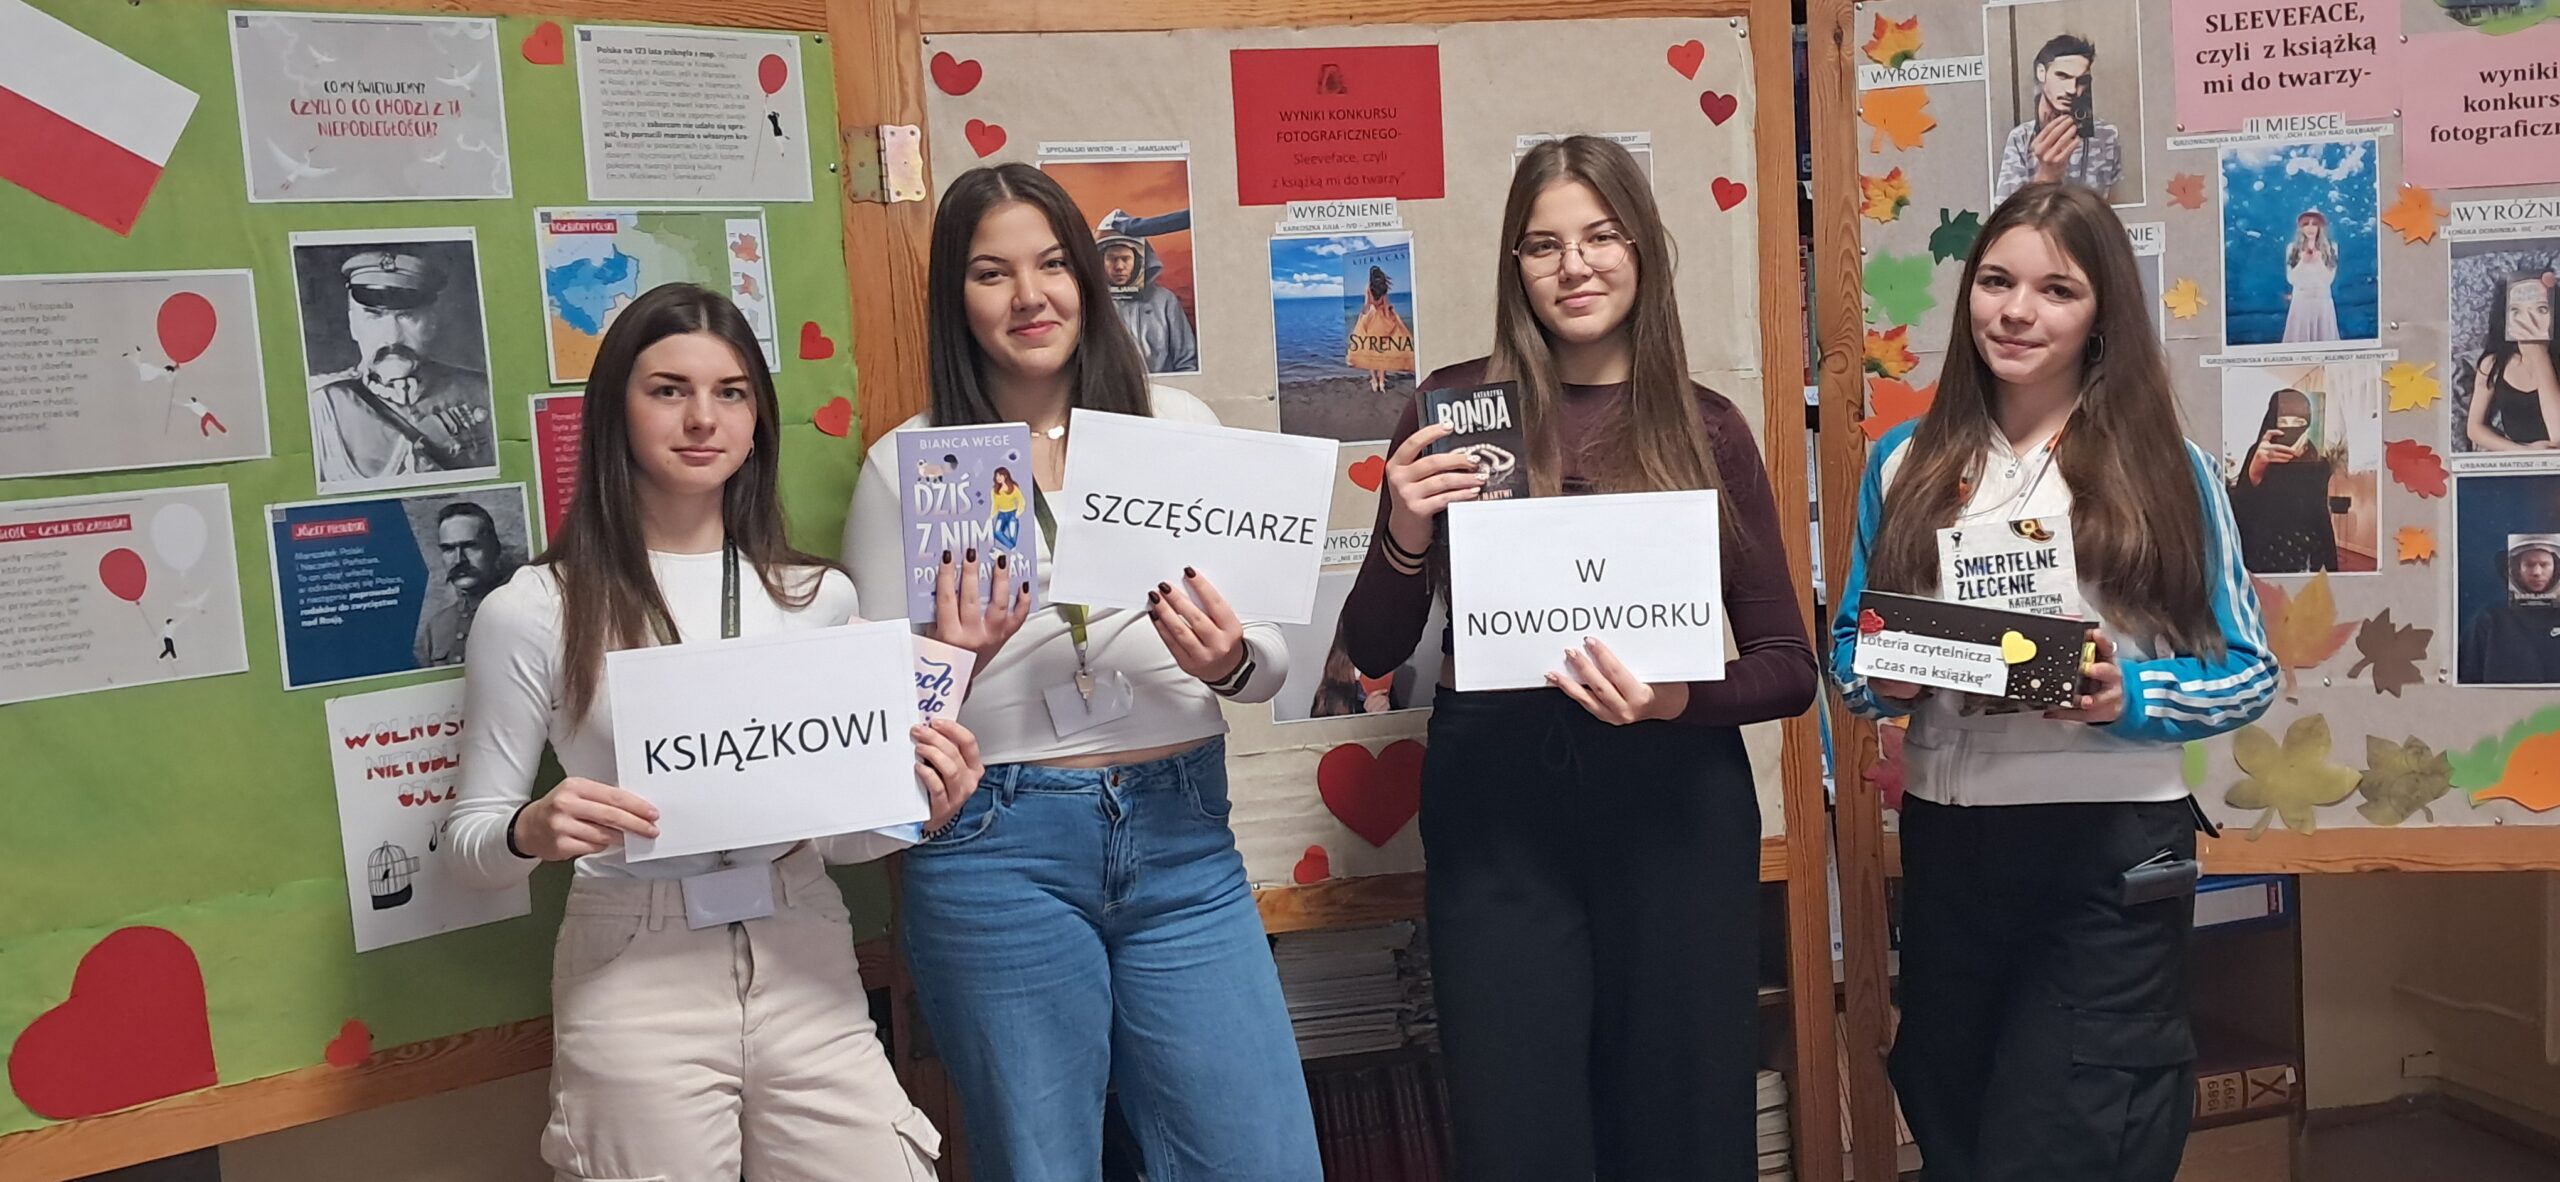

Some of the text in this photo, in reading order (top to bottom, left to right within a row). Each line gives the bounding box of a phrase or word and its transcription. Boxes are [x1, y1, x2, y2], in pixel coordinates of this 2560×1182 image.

[2206, 2, 2364, 33] SLEEVEFACE,
[2196, 33, 2377, 68] czyli z książką
[1871, 62, 1982, 84] WYRÓŻNIENIE
[2203, 68, 2371, 94] mi do twarzy-
[2479, 62, 2557, 88] wyniki
[324, 79, 426, 95] CO MY ŚWIĘTUJEMY?
[290, 98, 331, 116] CZYLI
[336, 98, 347, 116] O
[351, 98, 370, 116] CO
[375, 98, 429, 116] CHODZI
[433, 102, 445, 115] Z
[1279, 107, 1397, 122] WYNIKI KONKURSU
[317, 119, 438, 138] NIEPODLEGŁOŚCIĄ?
[1277, 128, 1402, 143] FOTOGRAFICZNEGO-
[2250, 115, 2337, 132] II MIEJSCE
[1363, 150, 1388, 165] czyli
[1282, 176, 1323, 190] książką
[1326, 176, 1341, 186] mi
[1344, 175, 1359, 186] do
[1291, 201, 1393, 219] WYRÓŻNIENIE
[1349, 333, 1415, 354] SYRENA
[1437, 395, 1512, 434] BONDA
[919, 435, 1010, 450] BIANCA WEGE
[914, 473, 972, 517] DZIŚ
[1082, 493, 1318, 546] SZCZĘŚCIARZE
[916, 519, 995, 558] Z NIM
[1575, 558, 1606, 582] W
[1954, 548, 2059, 579] ŚMIERTELNE
[1957, 573, 2037, 601] ZLECENIE
[2009, 593, 2063, 609] KATARZYNA
[1468, 602, 1710, 636] NOWODWORKU
[1861, 635, 1910, 652] Loteria
[1913, 643, 1992, 663] czytelnicza
[1866, 657, 1992, 690] „Czas na książkę”
[918, 692, 945, 713] do
[644, 709, 889, 774] KSIĄŻKOWI
